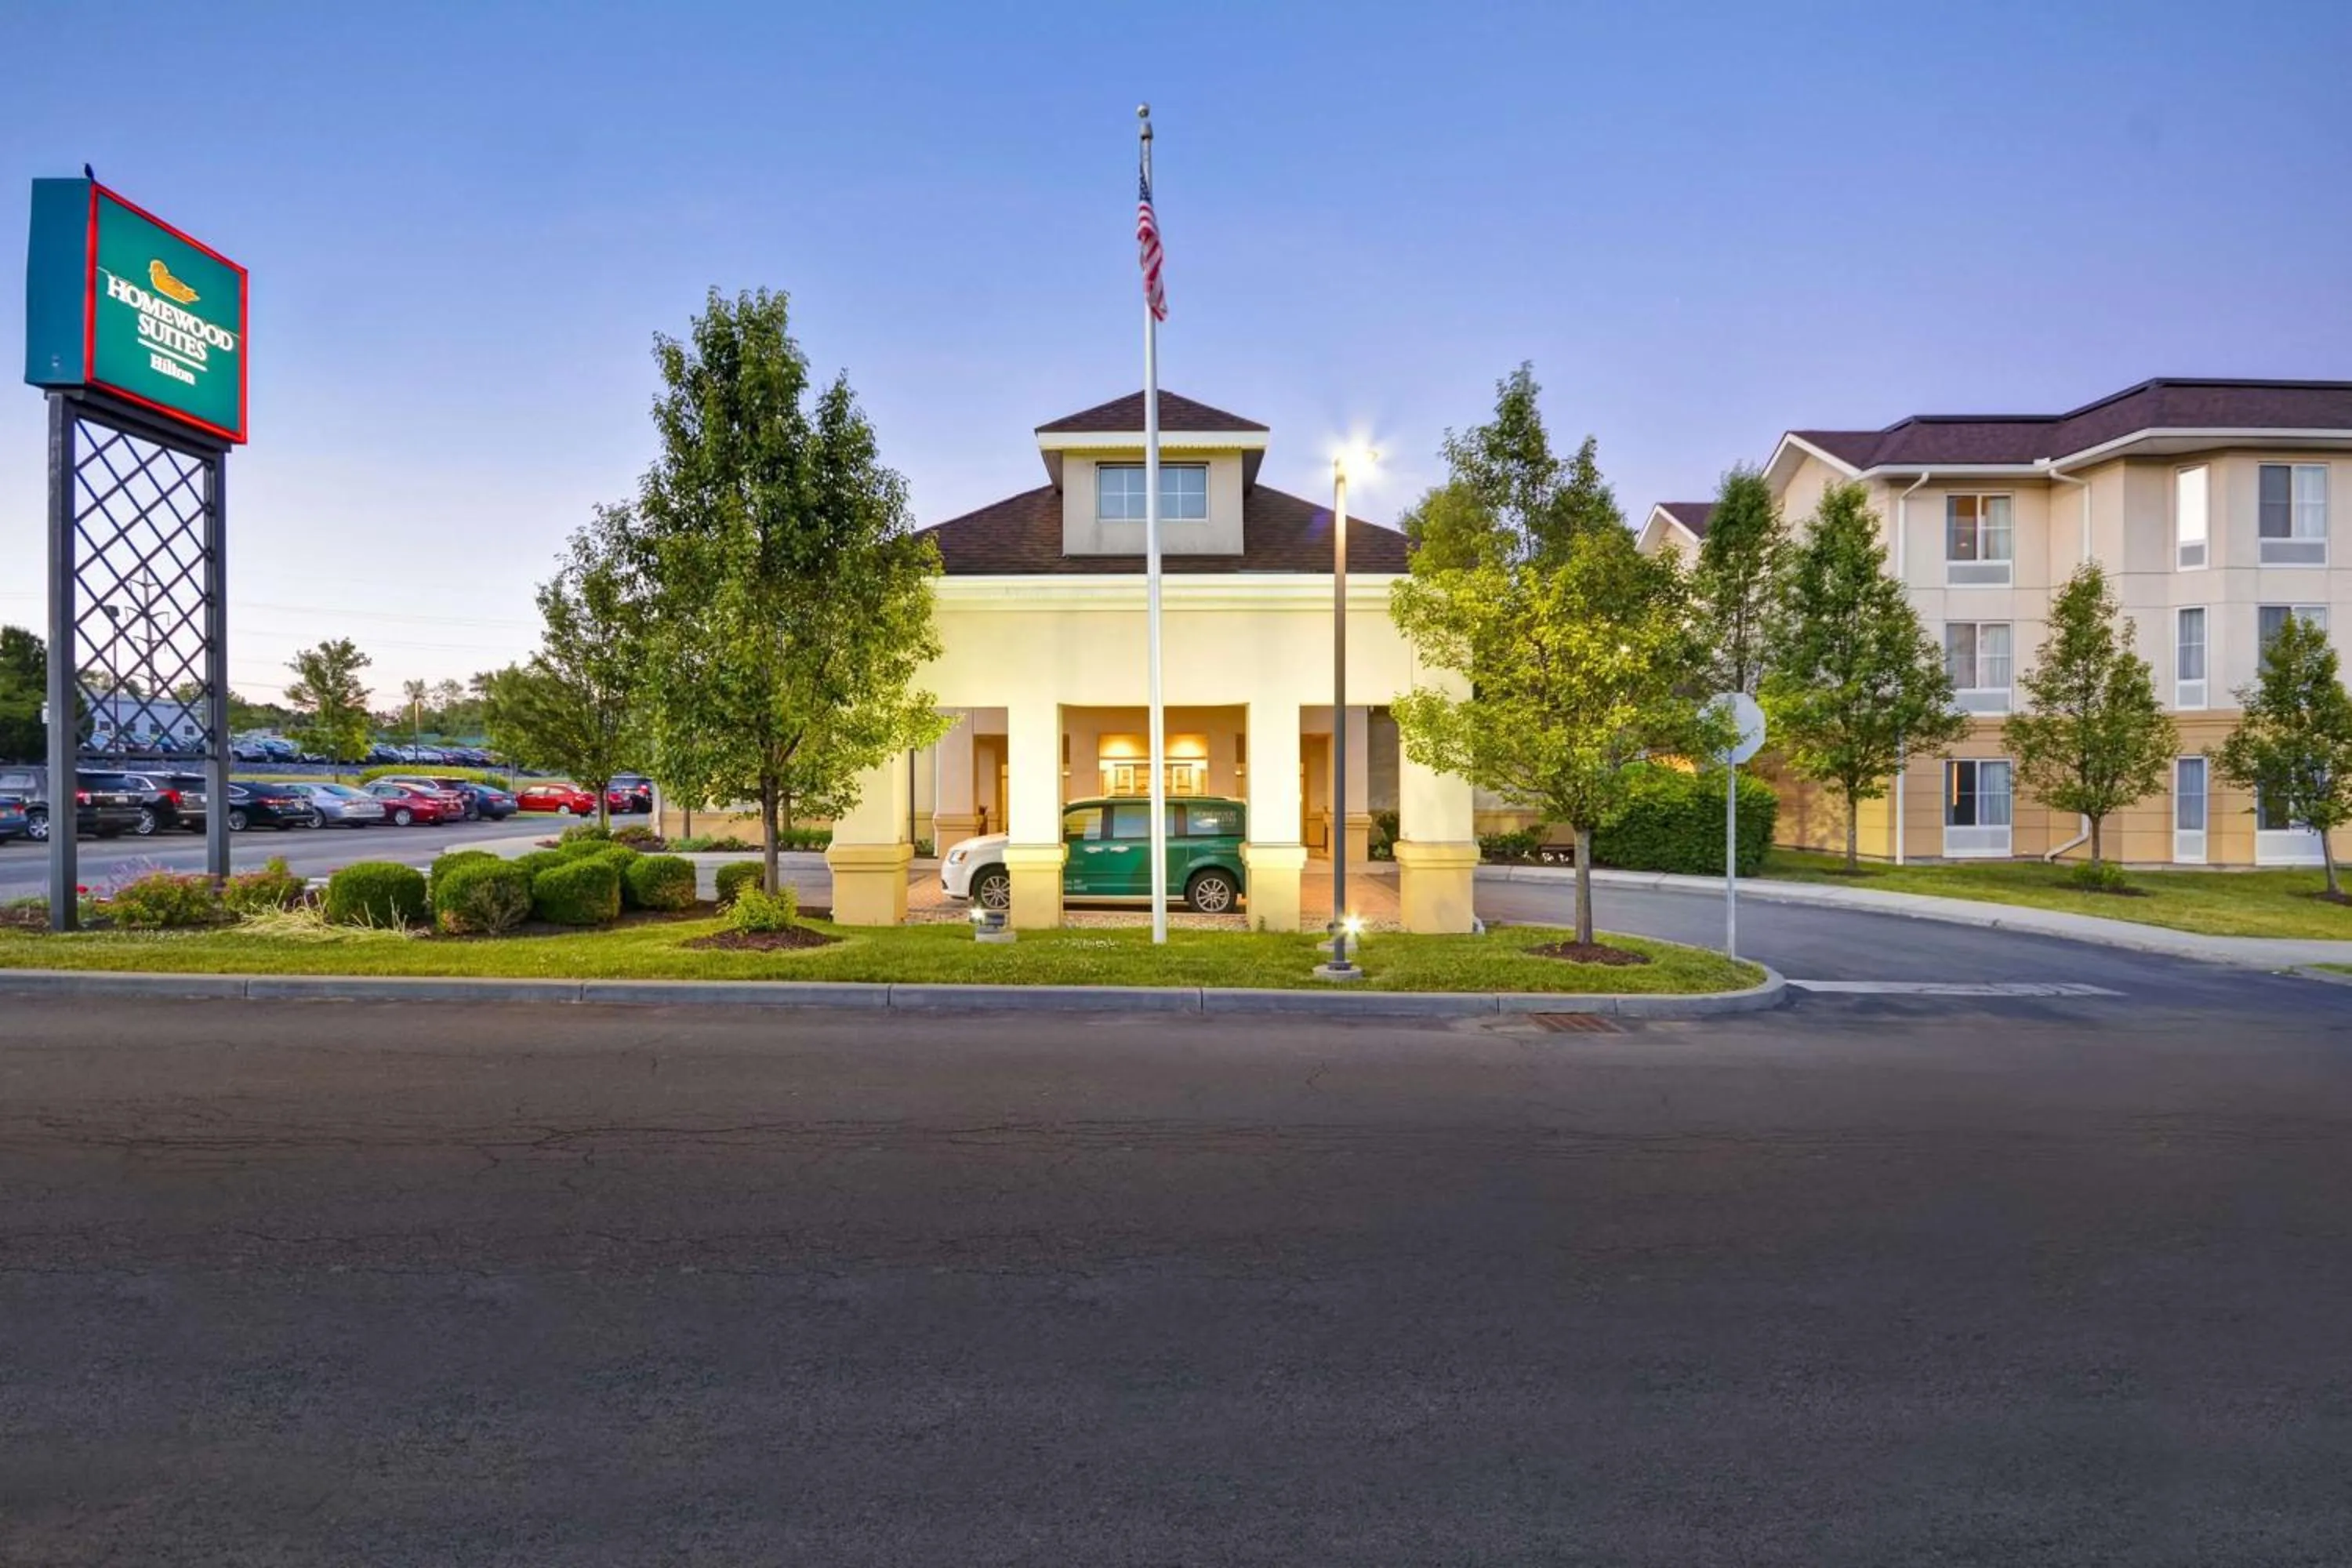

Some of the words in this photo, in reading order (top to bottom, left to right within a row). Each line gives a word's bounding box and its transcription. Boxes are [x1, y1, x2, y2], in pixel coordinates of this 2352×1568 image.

[107, 274, 234, 351] HOMEWOOD
[137, 314, 207, 361] SUITES
[150, 353, 195, 385] Hilton
